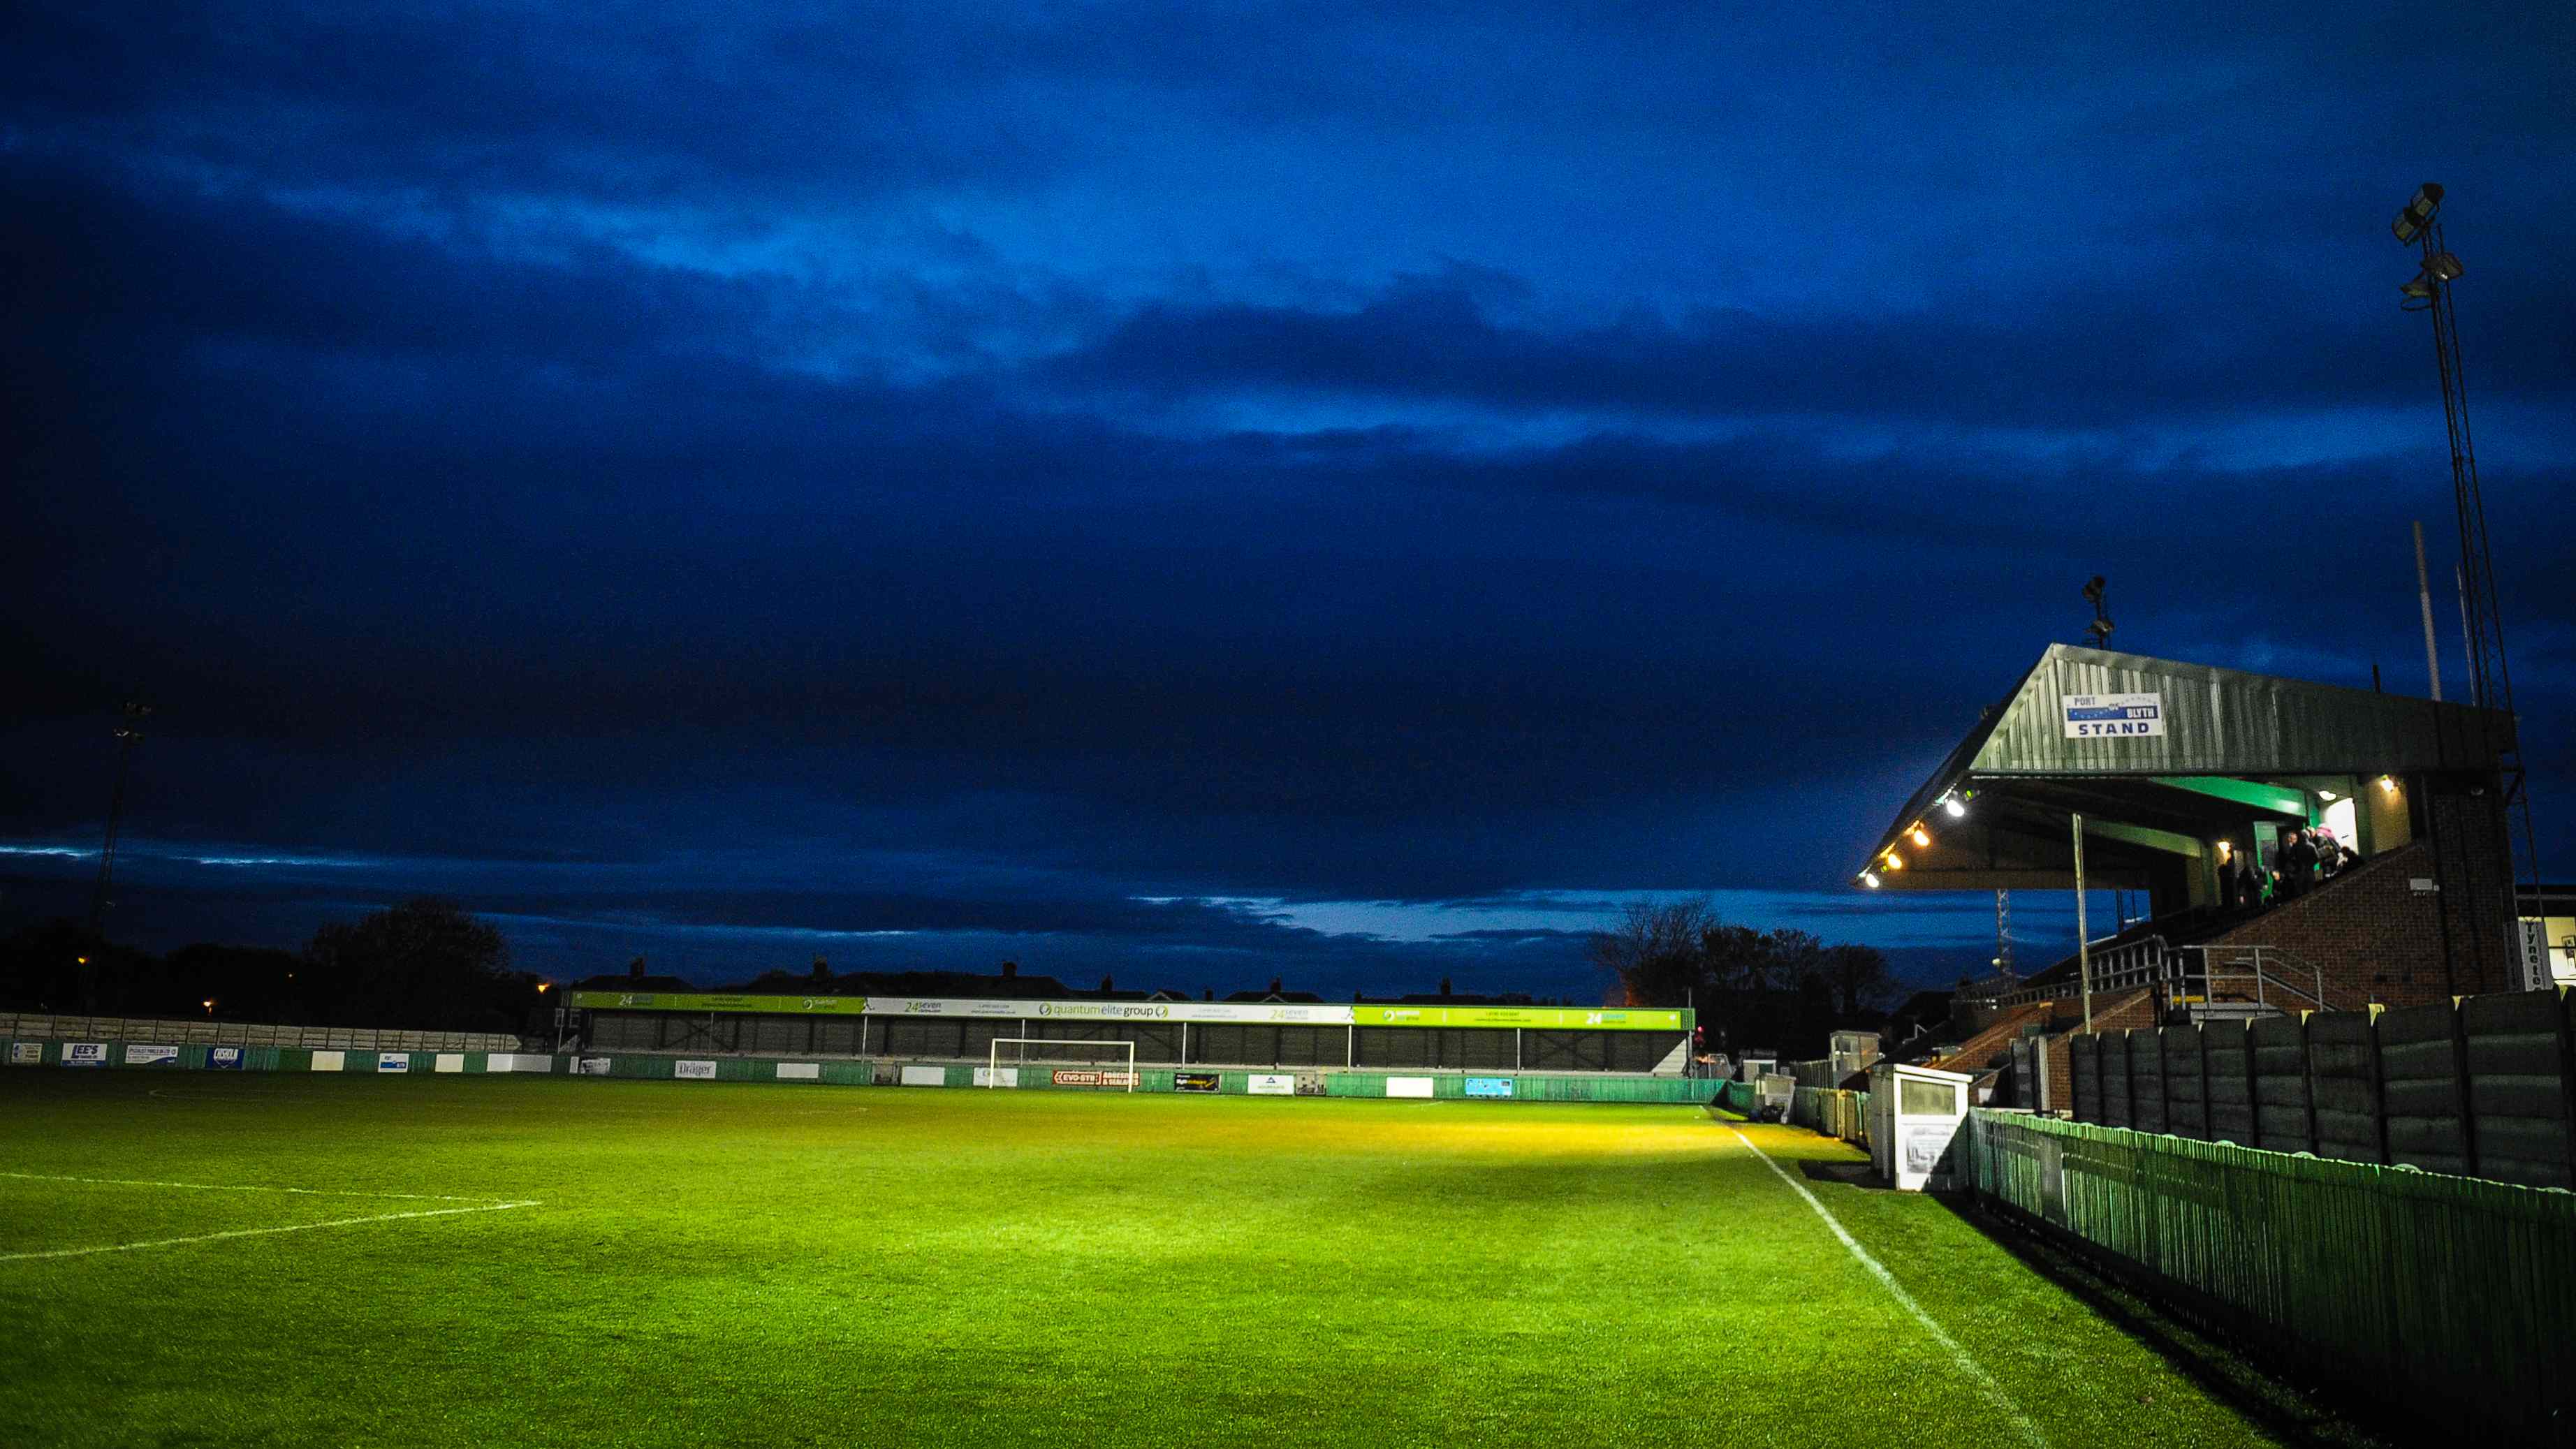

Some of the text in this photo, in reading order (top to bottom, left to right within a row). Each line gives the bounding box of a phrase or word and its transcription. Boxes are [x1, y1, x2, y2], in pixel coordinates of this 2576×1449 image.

[2074, 697, 2095, 706] PORT
[2126, 708, 2154, 718] BLYTH
[2079, 722, 2149, 735] STAND
[1054, 1004, 1153, 1018] quantum elite group
[71, 1045, 98, 1059] LEE'S
